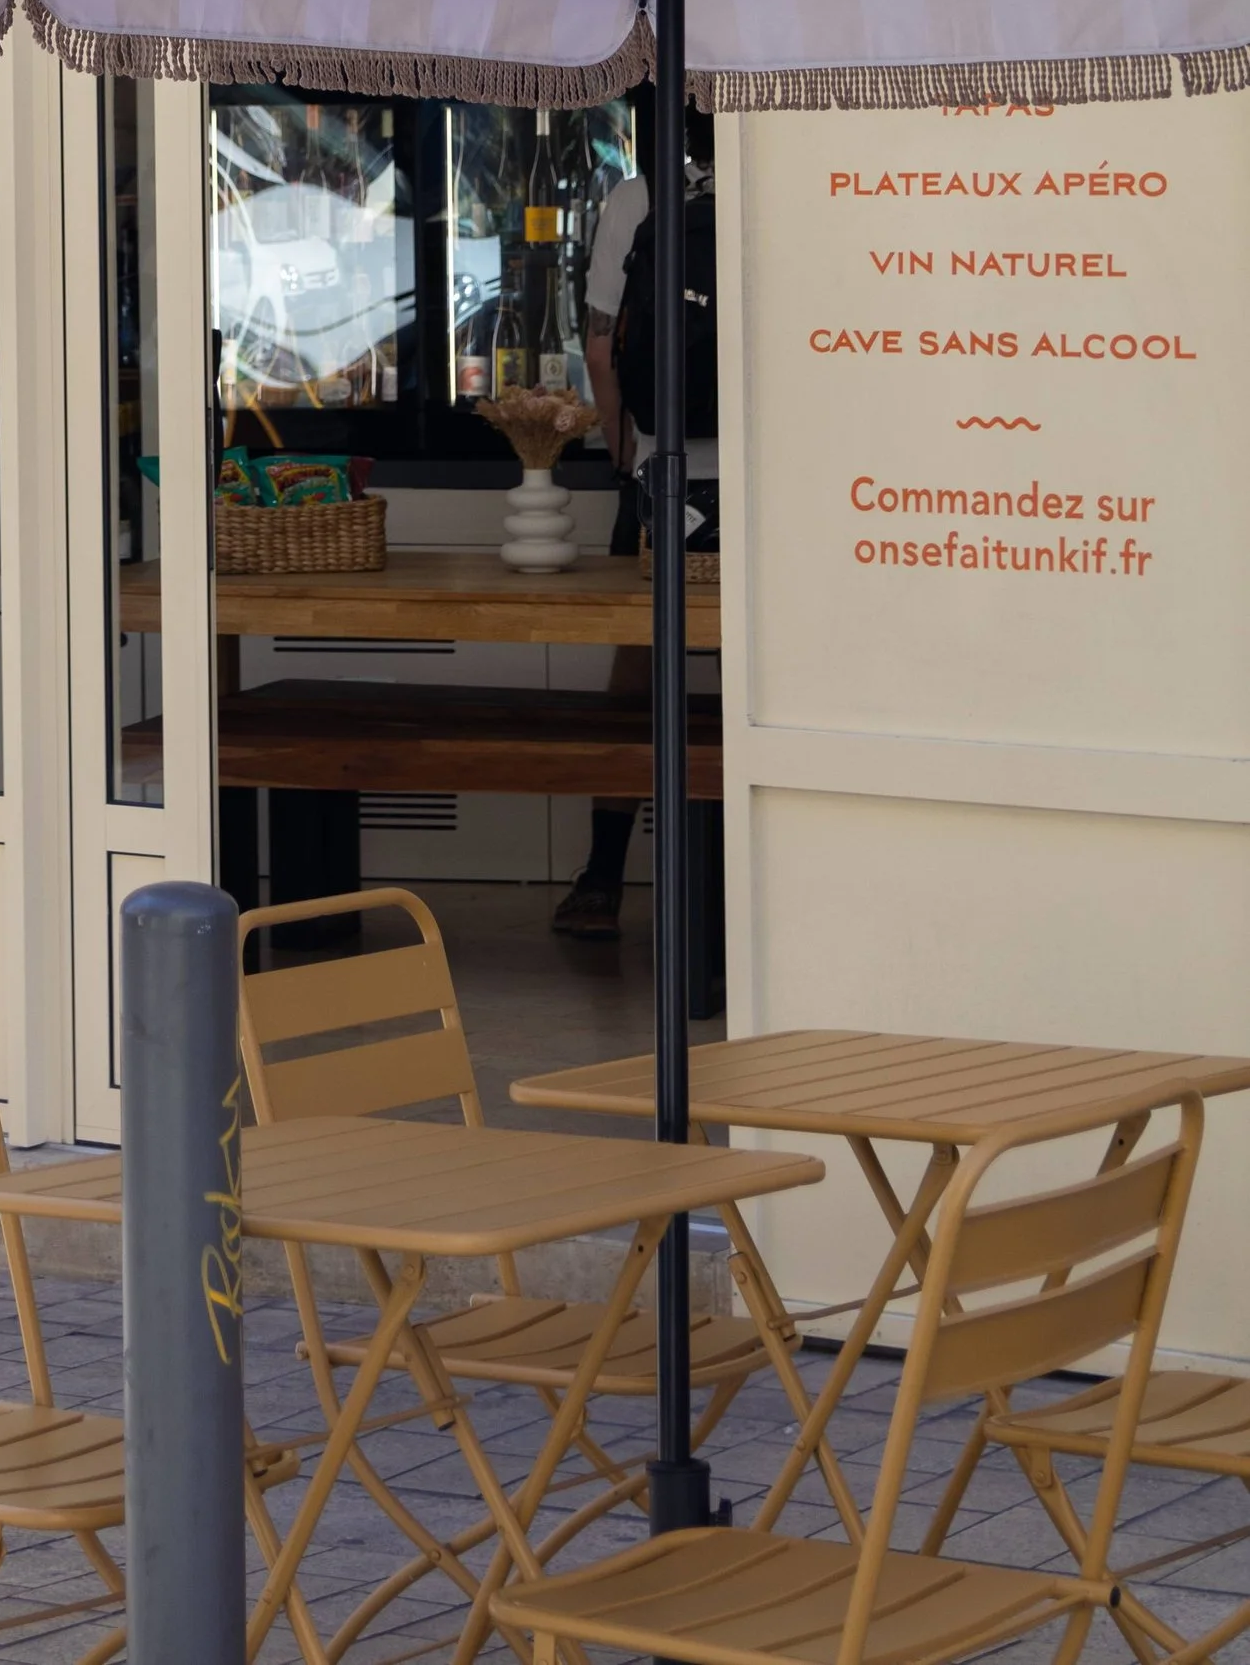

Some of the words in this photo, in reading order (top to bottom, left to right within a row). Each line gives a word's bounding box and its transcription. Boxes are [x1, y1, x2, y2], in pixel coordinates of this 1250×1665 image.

[829, 171, 1022, 198] PLATEAUX
[1034, 160, 1169, 198] APÉRO
[870, 251, 934, 275] VIN
[951, 251, 1128, 279] NATUREL
[809, 328, 904, 355] CAVE
[919, 330, 1020, 360] SANS
[1032, 333, 1198, 361] ALCOOL
[850, 475, 1084, 521] Commandez
[1097, 494, 1156, 523] sur
[853, 530, 1152, 576] onsefaitunkif.fr
